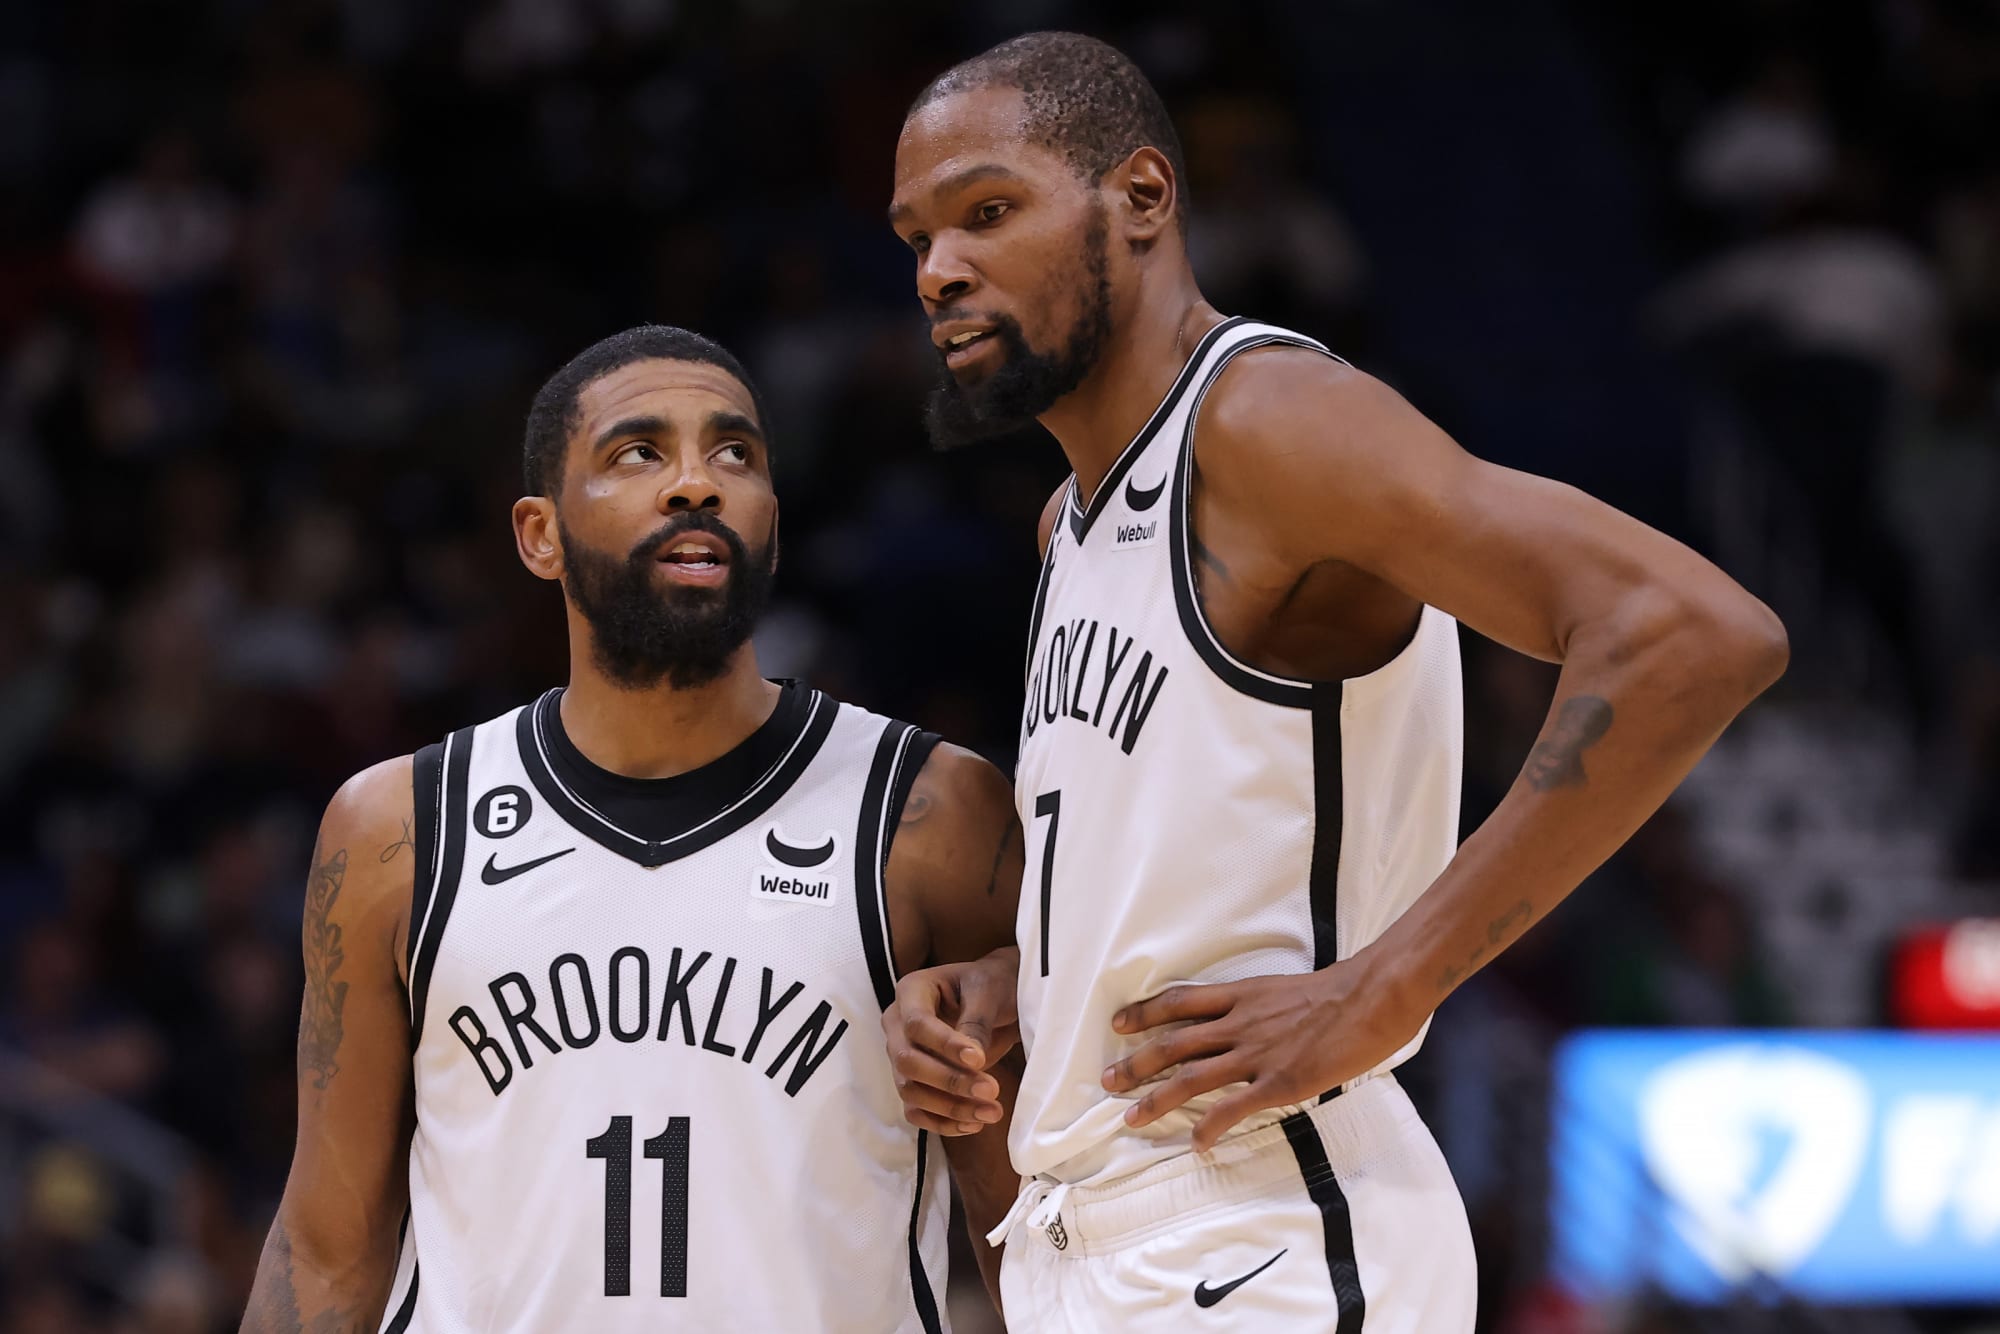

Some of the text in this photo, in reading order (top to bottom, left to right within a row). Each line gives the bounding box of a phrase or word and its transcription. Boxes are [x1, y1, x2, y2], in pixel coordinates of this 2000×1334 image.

[1117, 521, 1157, 543] Webull
[1020, 619, 1168, 755] OOKLYN
[487, 793, 519, 833] 6
[760, 875, 829, 899] Webull
[1035, 789, 1061, 977] 7
[449, 946, 849, 1098] BROOKLYN
[586, 1115, 690, 1297] 11
